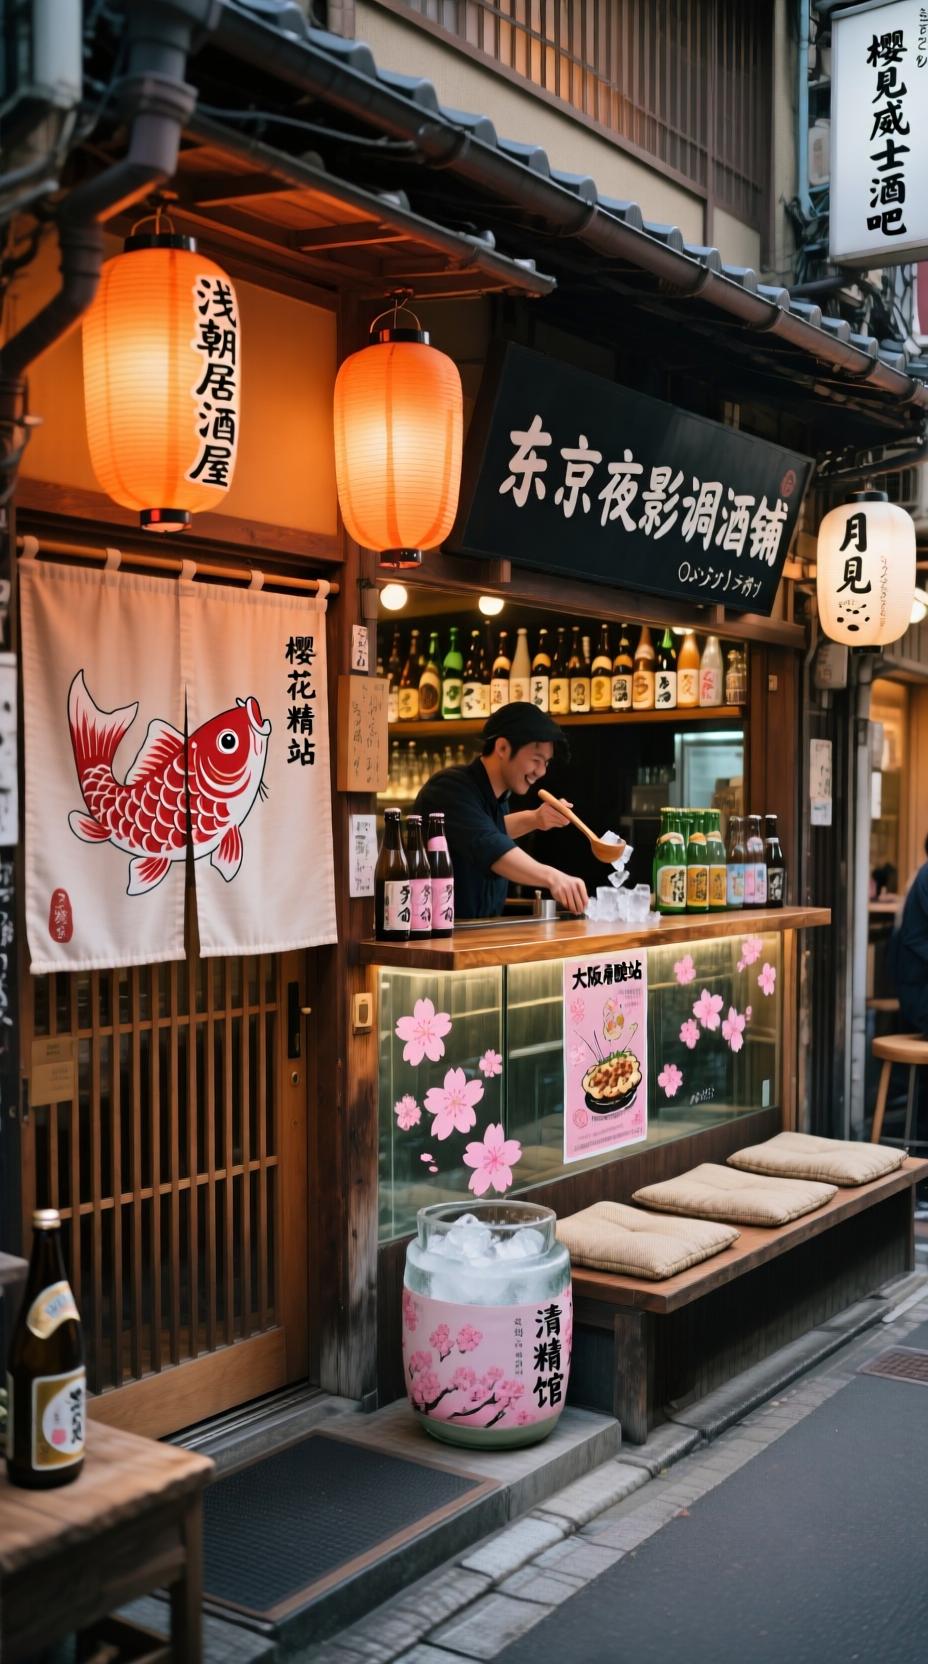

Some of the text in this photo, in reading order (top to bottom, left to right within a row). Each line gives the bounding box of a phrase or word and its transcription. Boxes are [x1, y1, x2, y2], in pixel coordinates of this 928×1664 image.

[190, 279, 237, 487] 浅朝居酒屋
[499, 415, 789, 568] 东京夜影调酒铺
[836, 512, 872, 594] 月見
[533, 1303, 564, 1409] 清精馆
